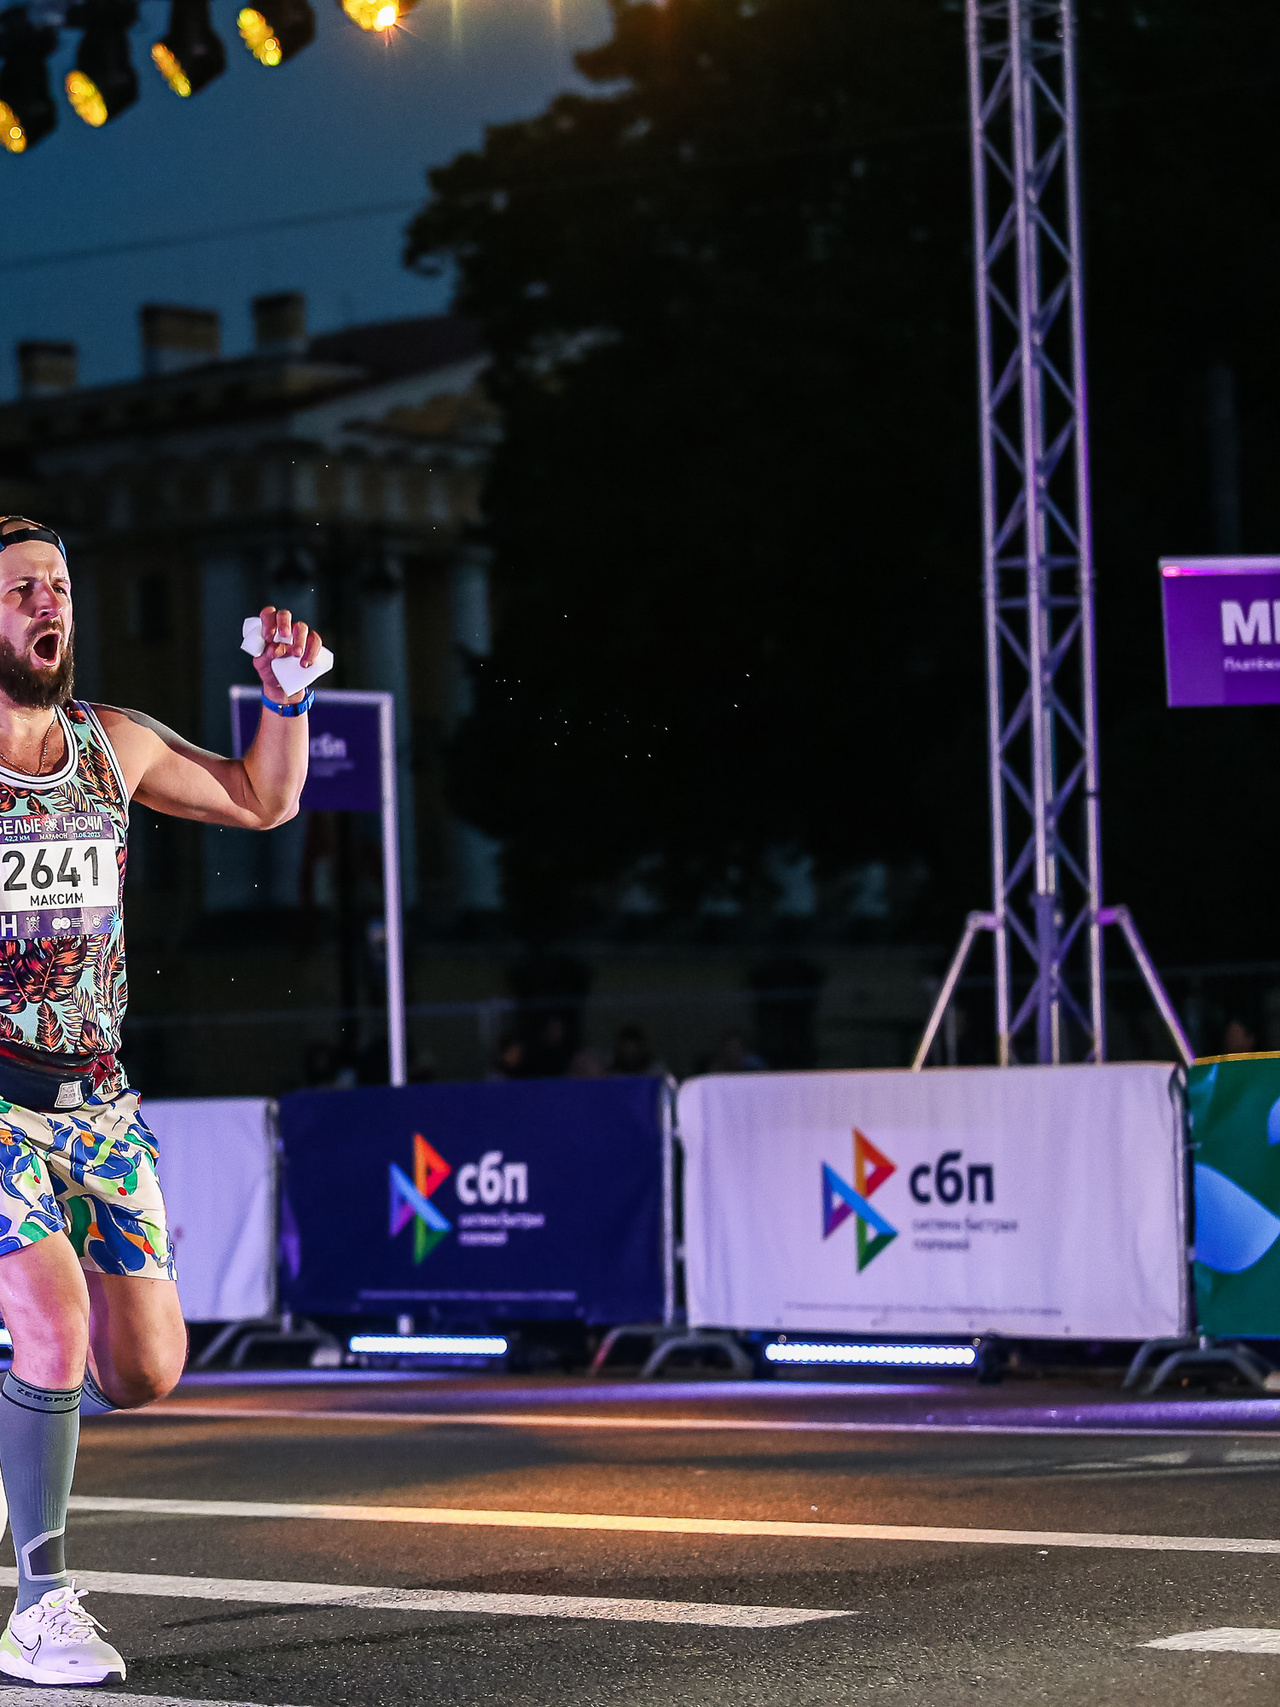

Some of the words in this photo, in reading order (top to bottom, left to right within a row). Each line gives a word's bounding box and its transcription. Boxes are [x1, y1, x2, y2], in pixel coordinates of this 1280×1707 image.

[1221, 600, 1280, 645] М
[62, 816, 103, 832] НОЧИ
[2, 847, 99, 892] 2641
[30, 893, 84, 907] МАКСИМ
[457, 1150, 528, 1204] сбп
[909, 1150, 994, 1205] сбп
